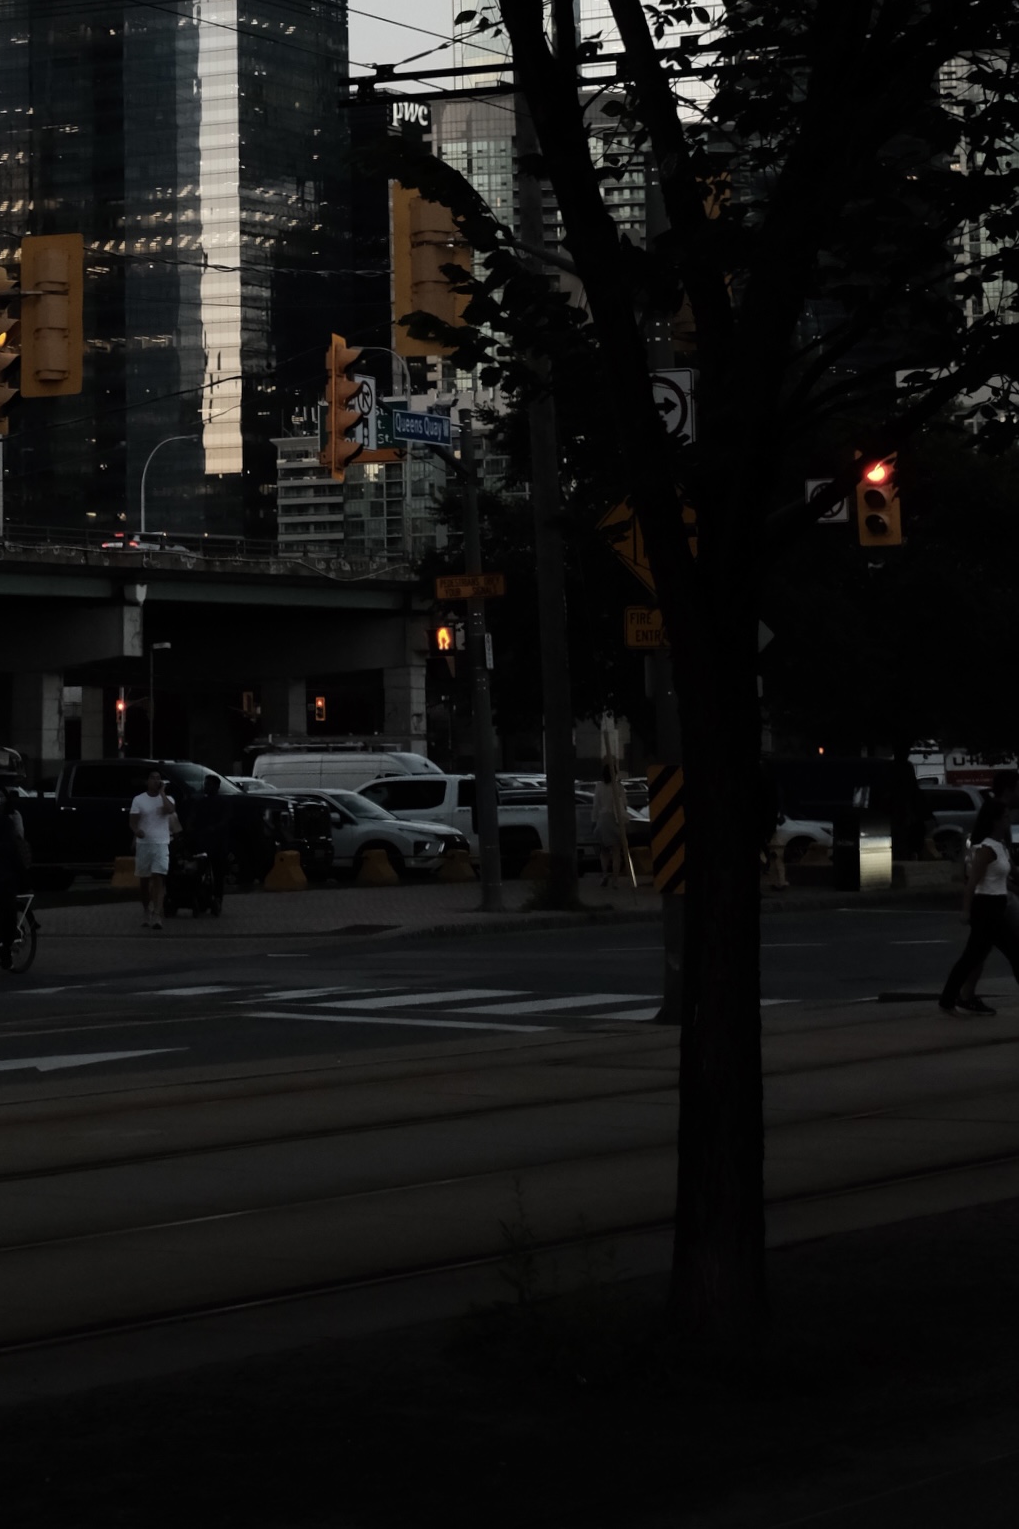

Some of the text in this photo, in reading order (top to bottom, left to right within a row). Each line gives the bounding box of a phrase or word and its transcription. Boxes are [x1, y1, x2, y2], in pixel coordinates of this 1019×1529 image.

[392, 101, 429, 127] pwc
[395, 412, 424, 435] Queens
[424, 416, 443, 441] Quay
[377, 433, 393, 445] St.
[629, 612, 652, 625] FIRE
